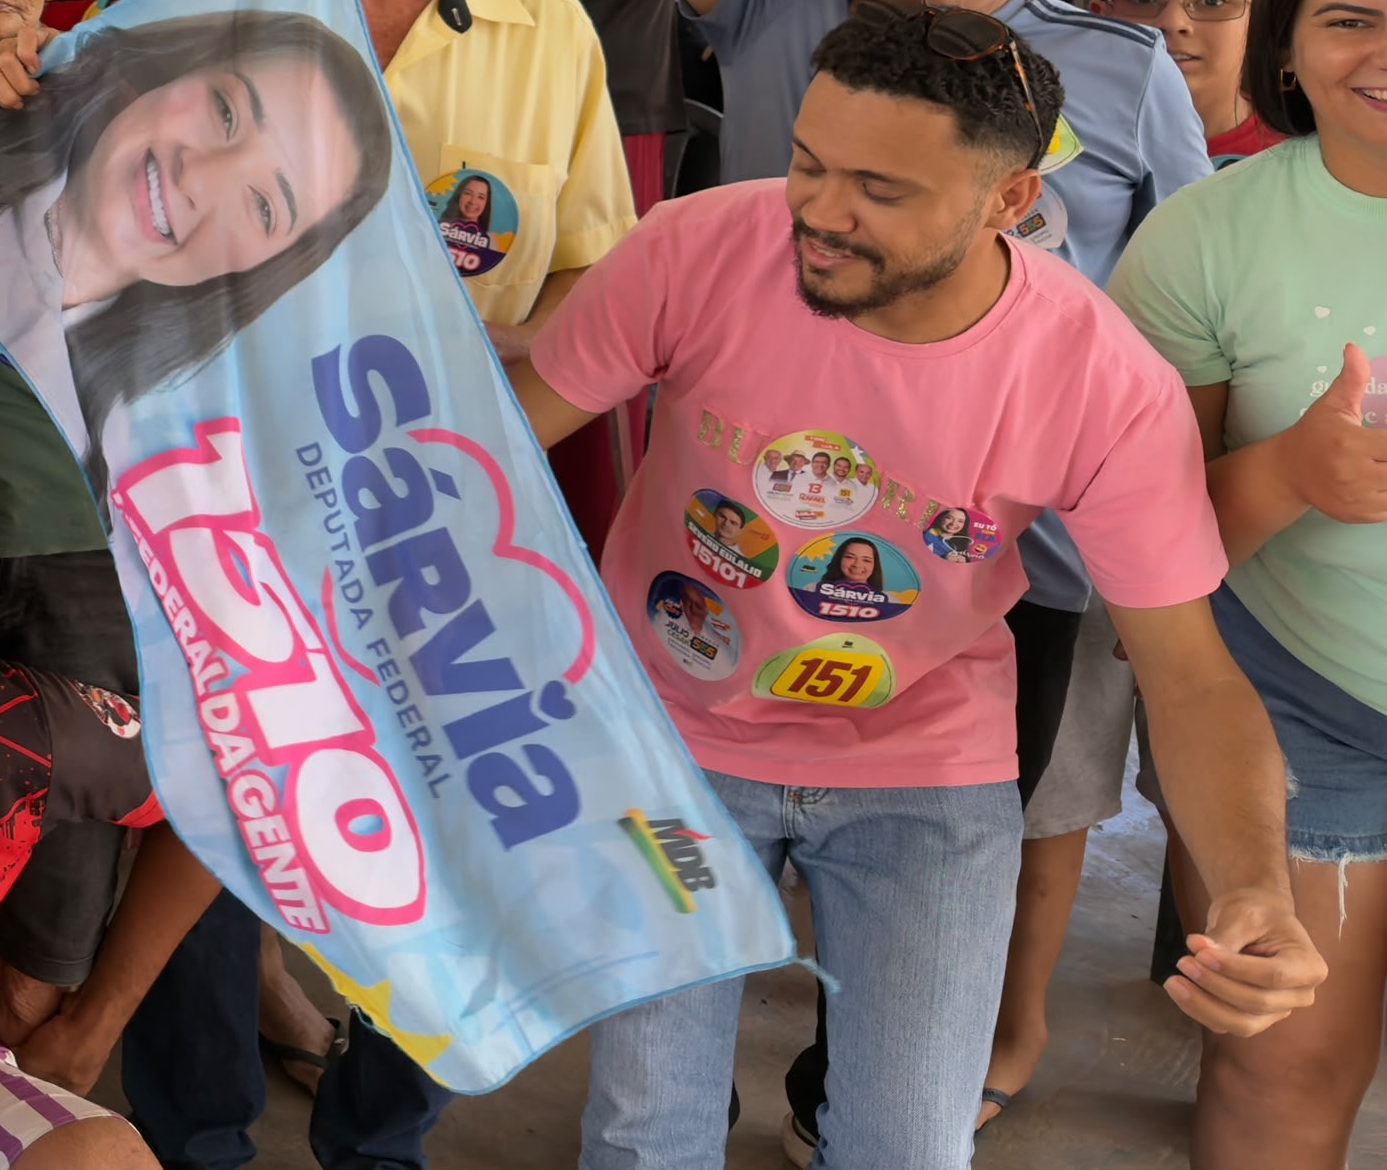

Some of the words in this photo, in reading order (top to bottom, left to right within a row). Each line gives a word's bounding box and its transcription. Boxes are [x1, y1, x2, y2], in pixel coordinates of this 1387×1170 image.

[311, 333, 582, 853] Sárvia
[692, 539, 747, 589] 15101
[819, 583, 885, 605] Sárvia
[295, 441, 376, 631] DEPUTADA
[367, 636, 455, 800] FEDERAL
[817, 601, 880, 620] 1510
[121, 422, 425, 918] 1510
[787, 657, 873, 702] 151
[199, 691, 243, 778] DA
[231, 770, 326, 931] GENTE
[649, 817, 718, 894] MDB
